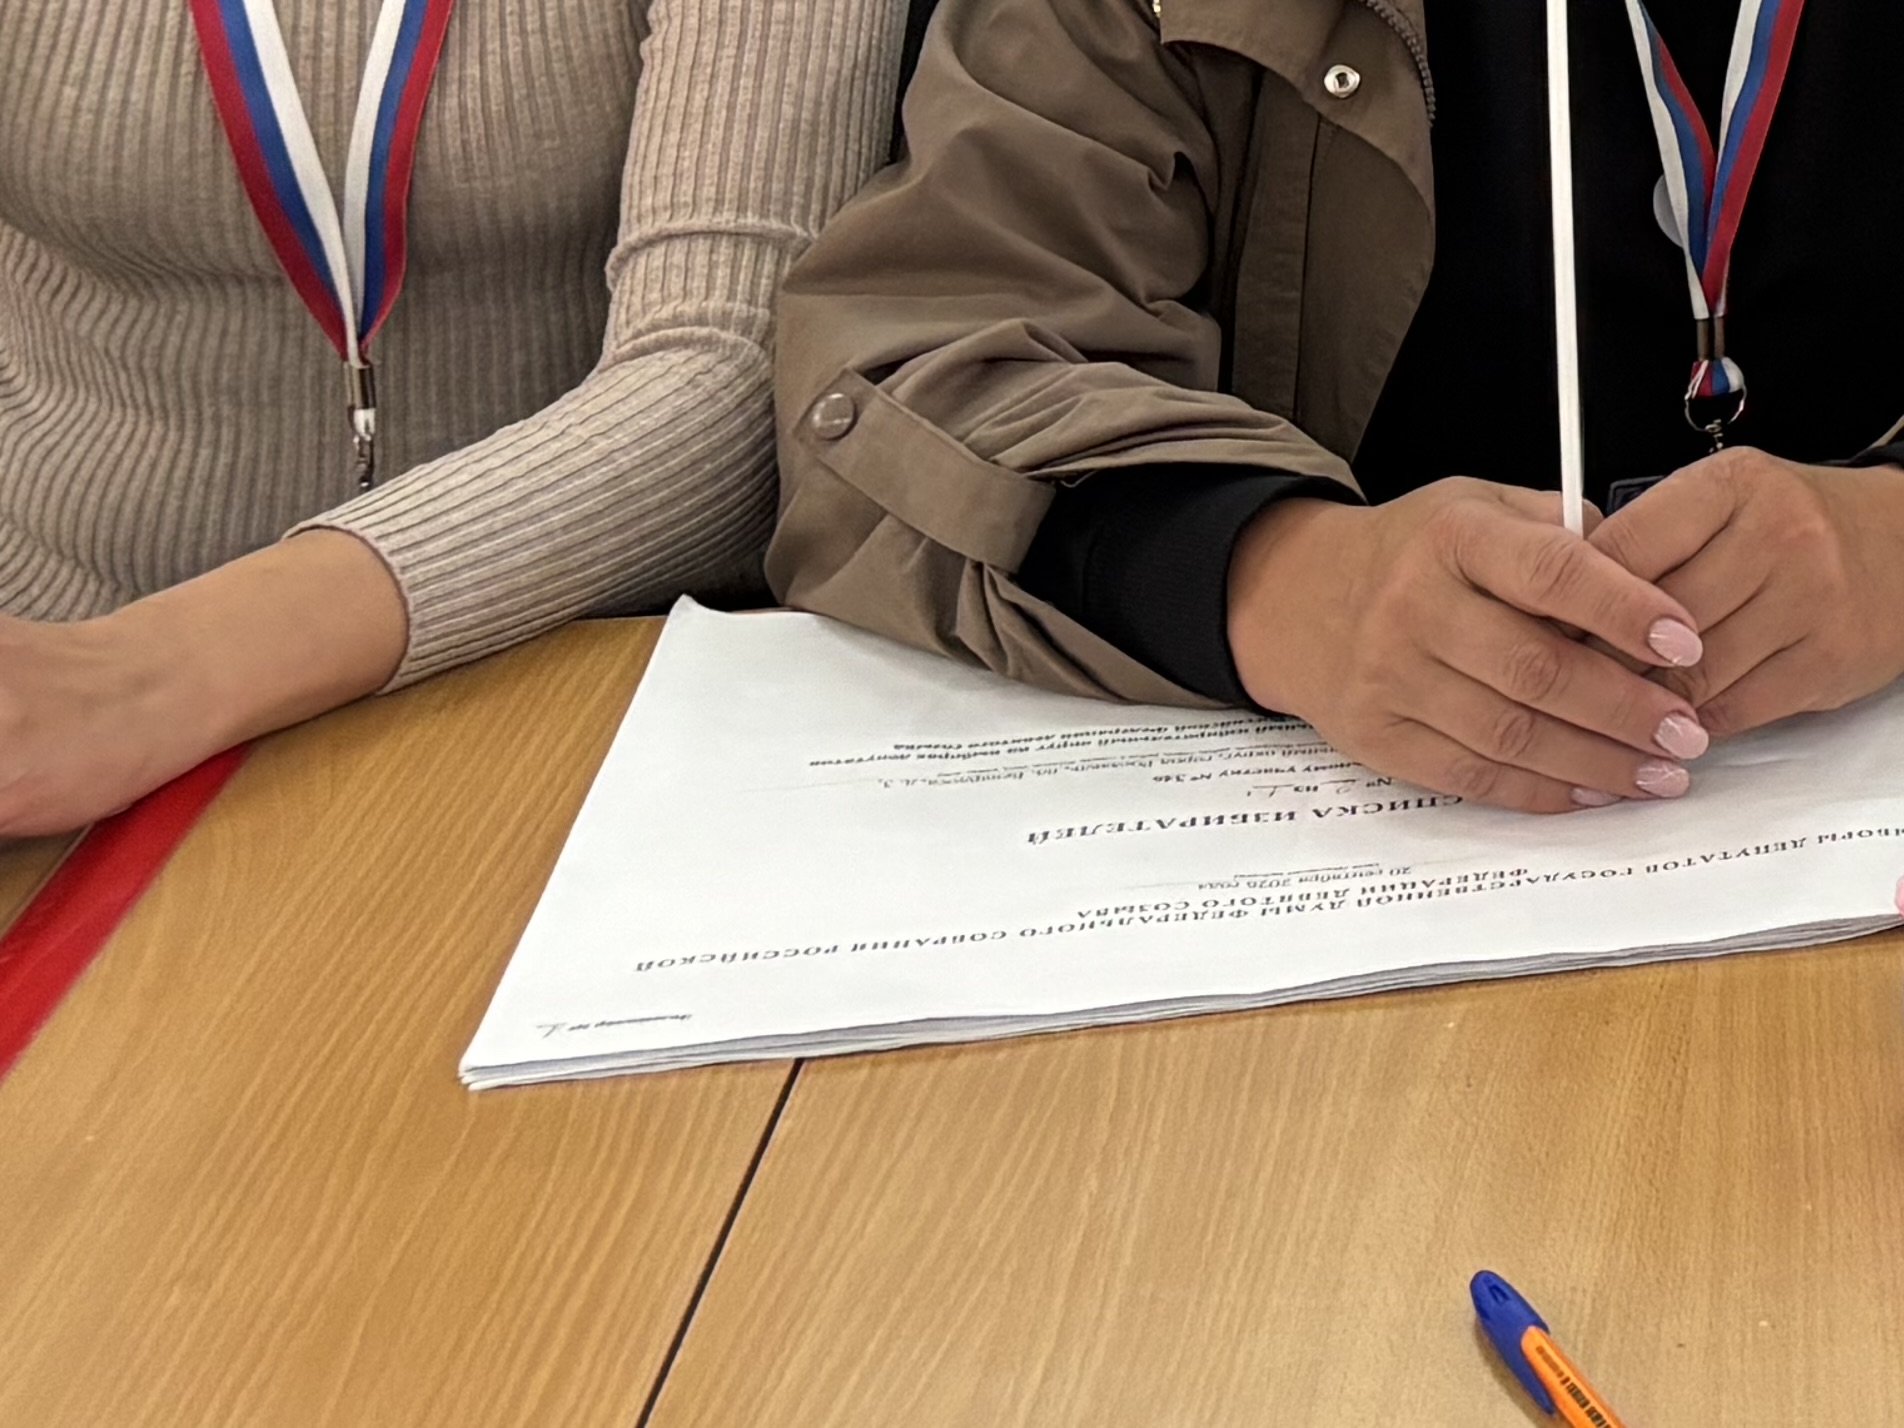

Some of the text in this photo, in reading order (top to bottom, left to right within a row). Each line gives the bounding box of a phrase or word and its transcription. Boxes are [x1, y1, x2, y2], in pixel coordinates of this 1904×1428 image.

[1028, 794, 1464, 845] СПИСКА ИЗБИРАТЕЛЕЙ
[1646, 837, 1807, 872] ДЕПУТАТОВ
[1298, 869, 1384, 883] сентября
[1390, 865, 1412, 875] 20
[1077, 867, 1528, 919] ФЕДЕРАЦИИ ДЕВЯТОГО СОЗЫВА
[1357, 867, 1633, 911] ГОСУДАРСТВЕННОЙ
[1019, 908, 1249, 937] ФЕДЕРАЛЬНОГО
[1261, 900, 1345, 917] ДУМЫ
[852, 929, 1007, 952] СОБРАНИЯ
[633, 944, 839, 972] РОССИЙСКОЙ
